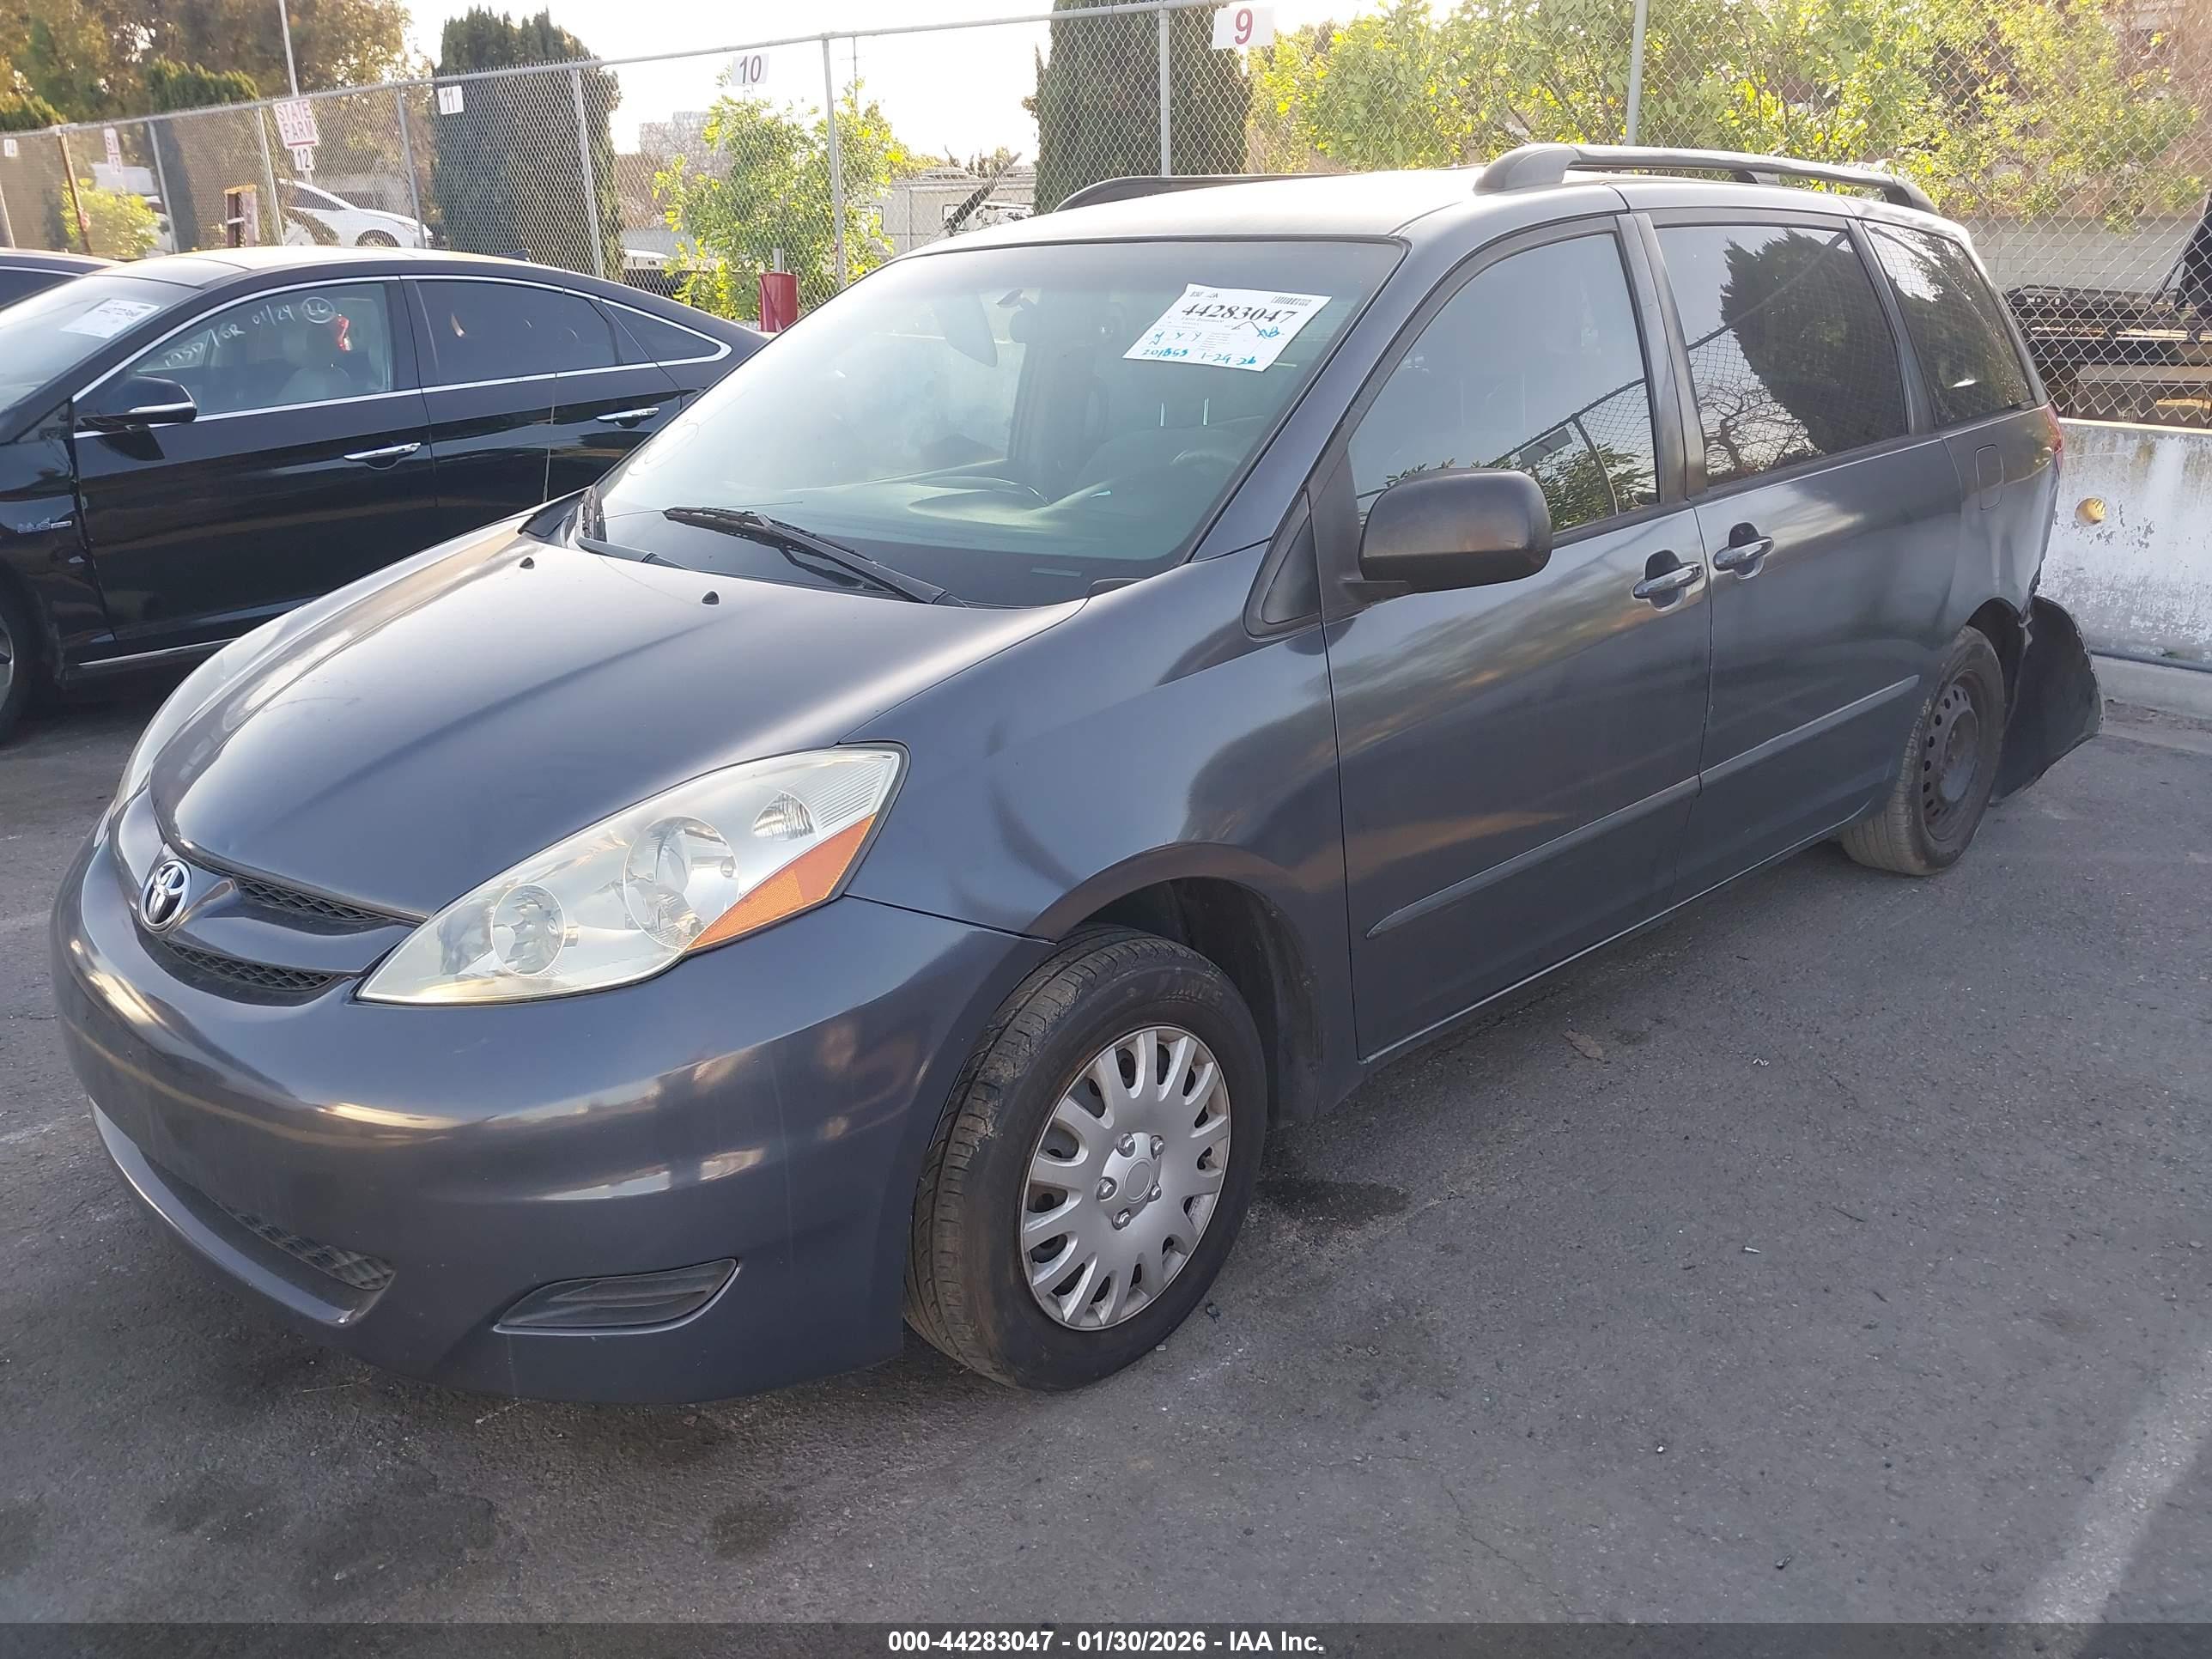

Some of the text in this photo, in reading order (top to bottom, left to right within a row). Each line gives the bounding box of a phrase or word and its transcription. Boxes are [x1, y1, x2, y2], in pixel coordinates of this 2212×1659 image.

[1234, 8, 1253, 46] 9
[739, 55, 762, 84] 10
[443, 88, 456, 112] 11
[276, 101, 312, 122] STATE
[283, 119, 315, 141] FARM
[297, 149, 311, 169] 12
[1182, 303, 1298, 324] 44283047
